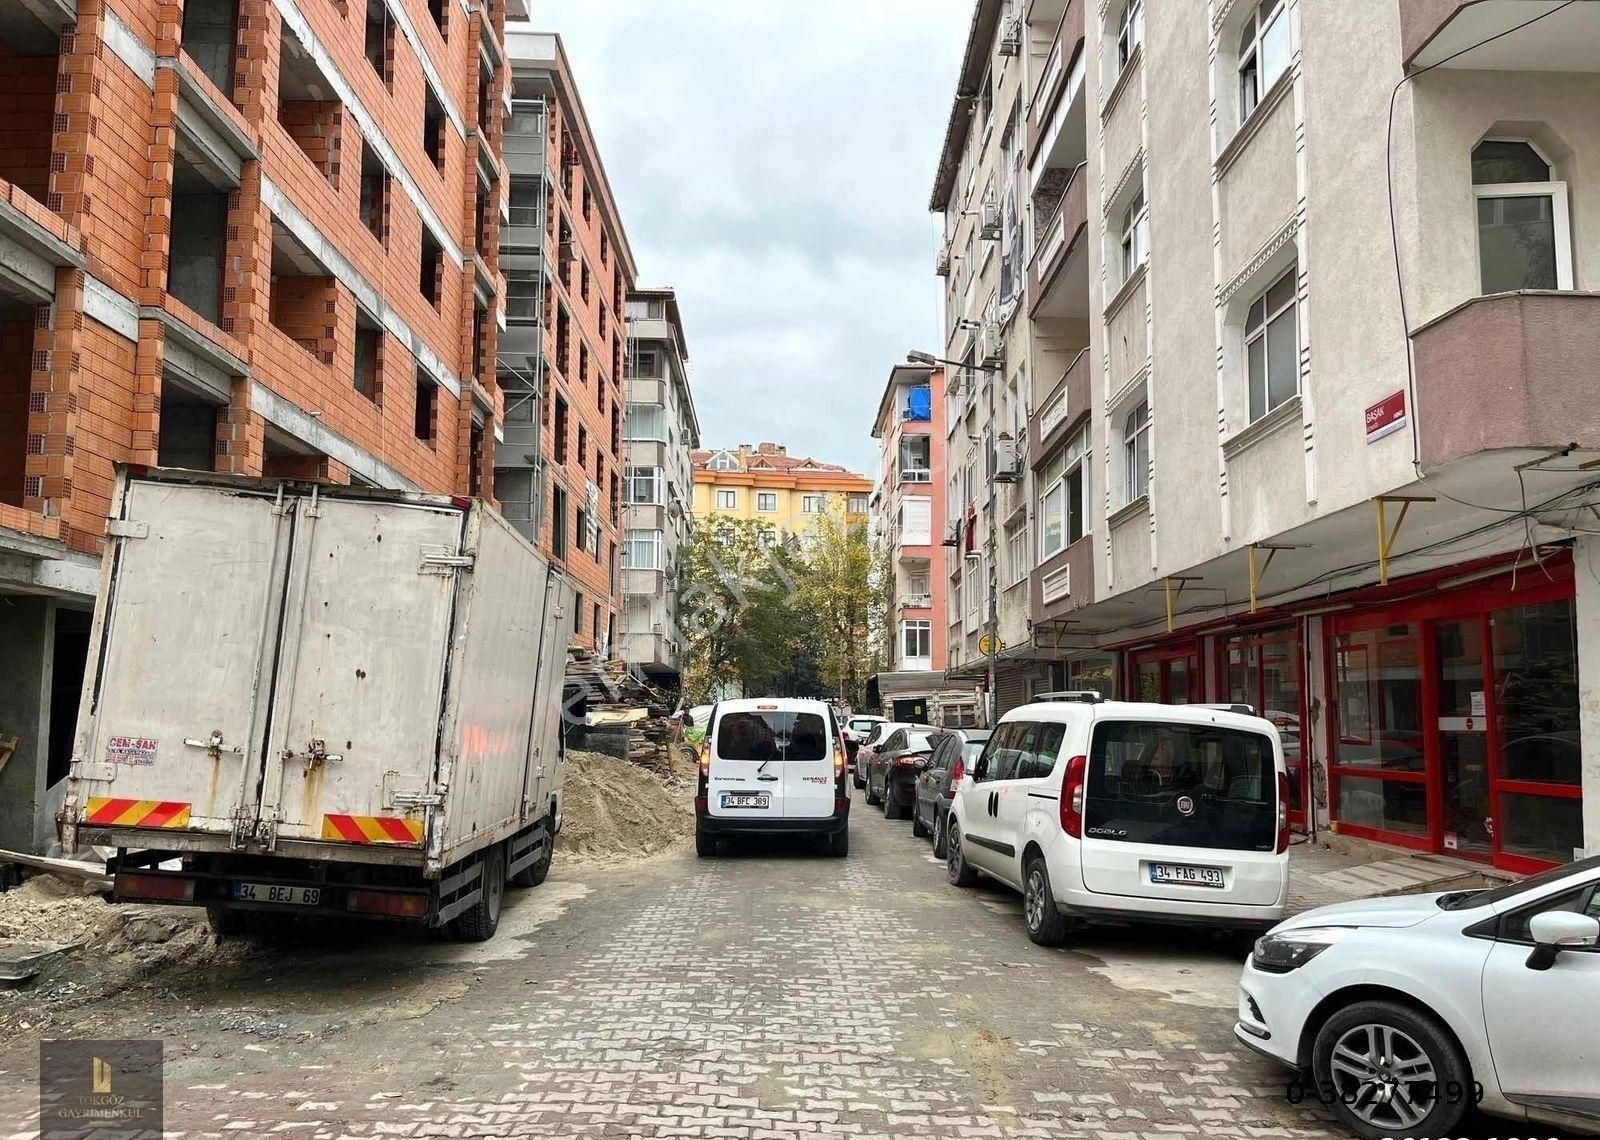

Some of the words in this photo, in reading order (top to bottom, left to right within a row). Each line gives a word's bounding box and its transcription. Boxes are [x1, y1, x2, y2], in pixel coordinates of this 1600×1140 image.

[1366, 405, 1385, 424] BAŞAK
[726, 797, 735, 805] 34
[737, 797, 751, 805] BFC
[753, 797, 767, 805] 389
[1157, 866, 1170, 878] 34
[1176, 867, 1196, 880] FAG
[1201, 870, 1220, 882] 493
[240, 885, 256, 899] 34
[269, 886, 294, 902] BEJ
[302, 889, 319, 904] 69
